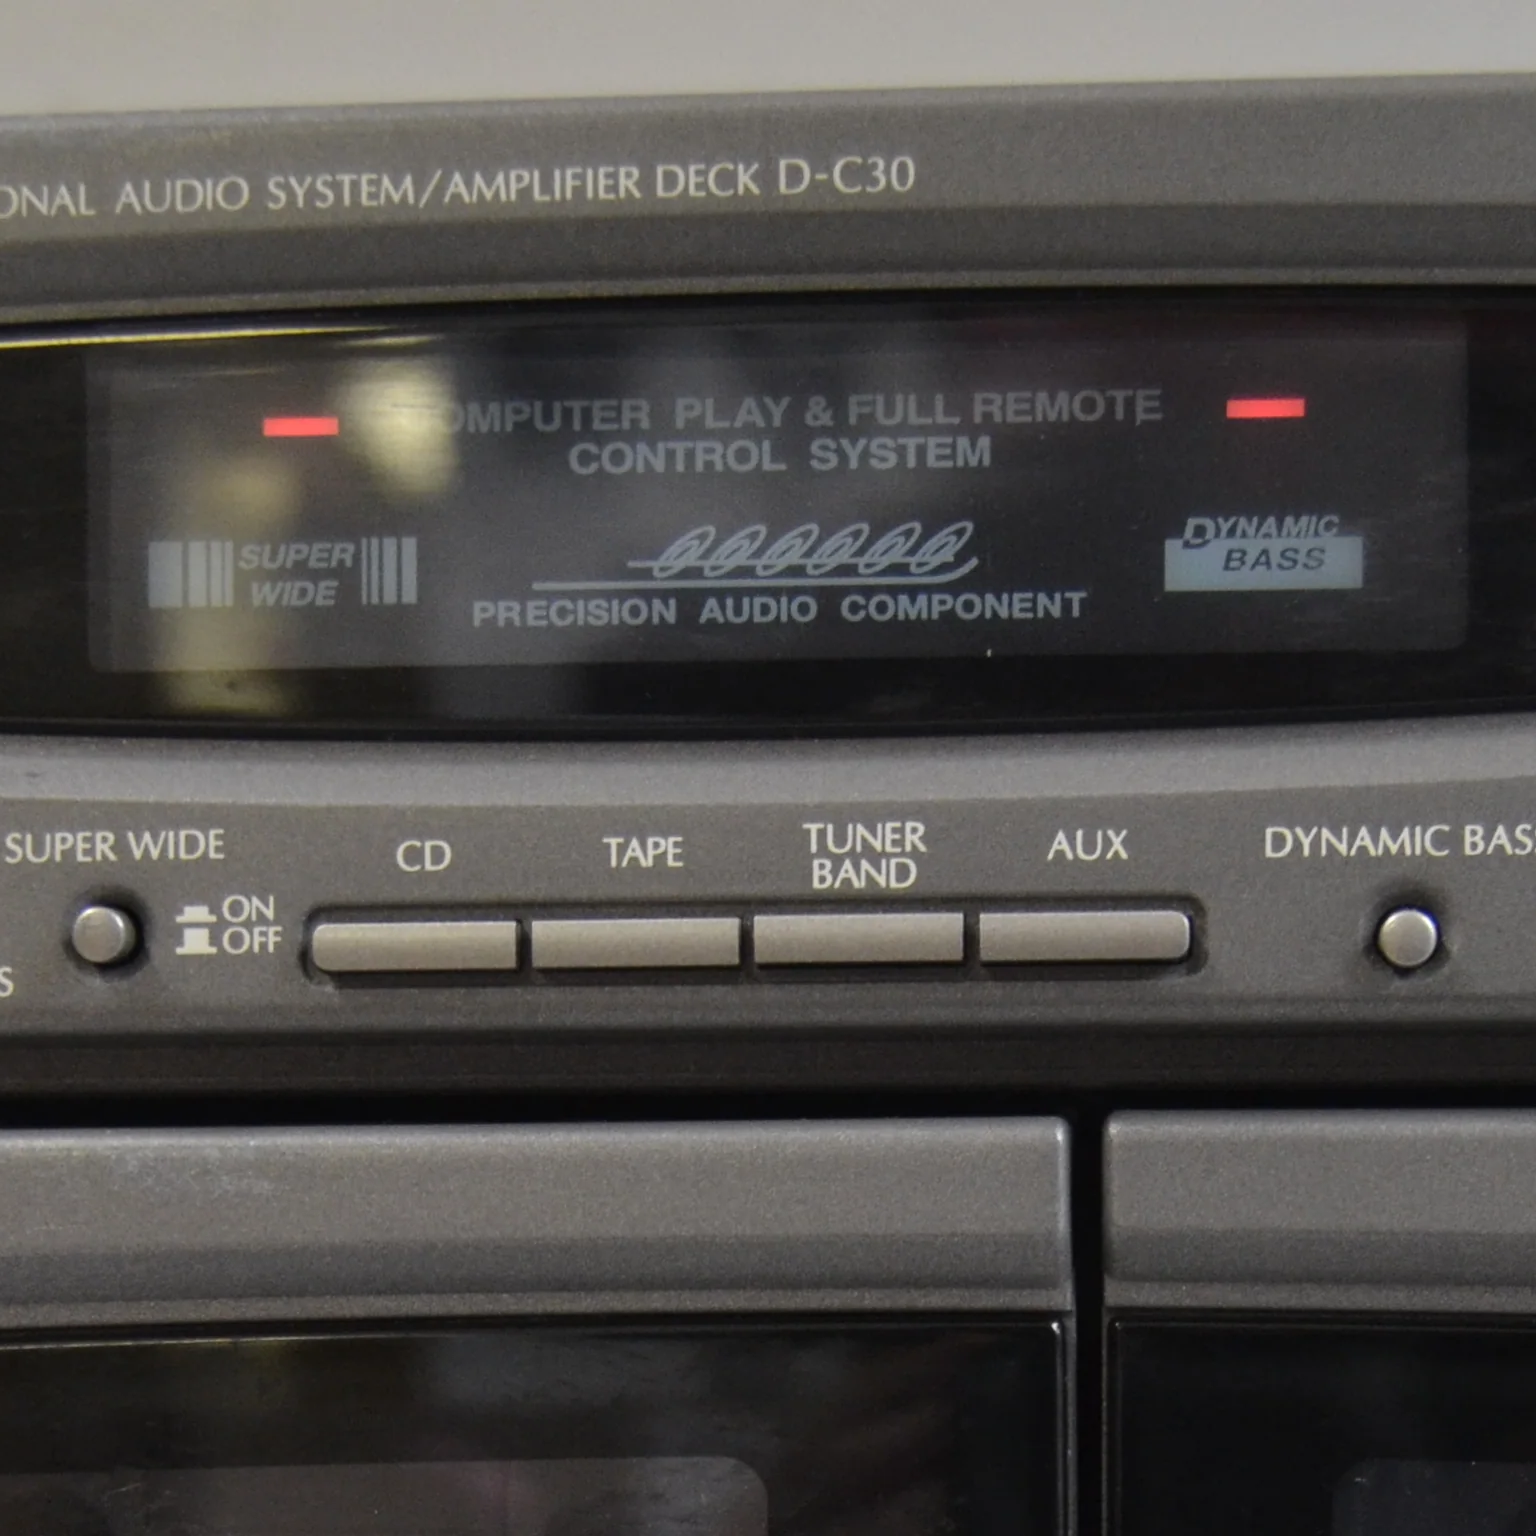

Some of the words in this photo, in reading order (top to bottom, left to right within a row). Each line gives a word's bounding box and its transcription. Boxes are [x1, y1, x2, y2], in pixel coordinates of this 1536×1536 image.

[116, 177, 249, 214] AUDIO
[267, 161, 642, 209] SYSTEM/AMPLIFIER
[656, 158, 761, 199] DECK
[778, 156, 916, 195] D-C30
[676, 395, 791, 430] PLAY
[805, 395, 834, 428] &
[849, 392, 961, 426] FULL
[974, 389, 1163, 424] REMOTE
[569, 439, 785, 475] CONTROL
[810, 435, 991, 470] SYSTEM
[1182, 514, 1341, 550] DYNAMIC
[239, 541, 356, 571] SUPER
[1222, 547, 1326, 572] BASS
[250, 579, 339, 608] WIDE
[473, 598, 676, 628] PRECISION
[699, 595, 818, 625] AUDIO
[840, 591, 1088, 622] COMPONENT
[5, 830, 117, 864] SUPER
[128, 828, 225, 861] WIDE
[603, 836, 684, 868] TAPE
[802, 821, 927, 855] TUNER
[1047, 829, 1129, 861] AUX
[1264, 825, 1450, 859] DYNAMIC
[396, 839, 453, 872] CD
[812, 857, 918, 890] BAND
[222, 894, 275, 923] ON
[222, 926, 283, 955] OFF
